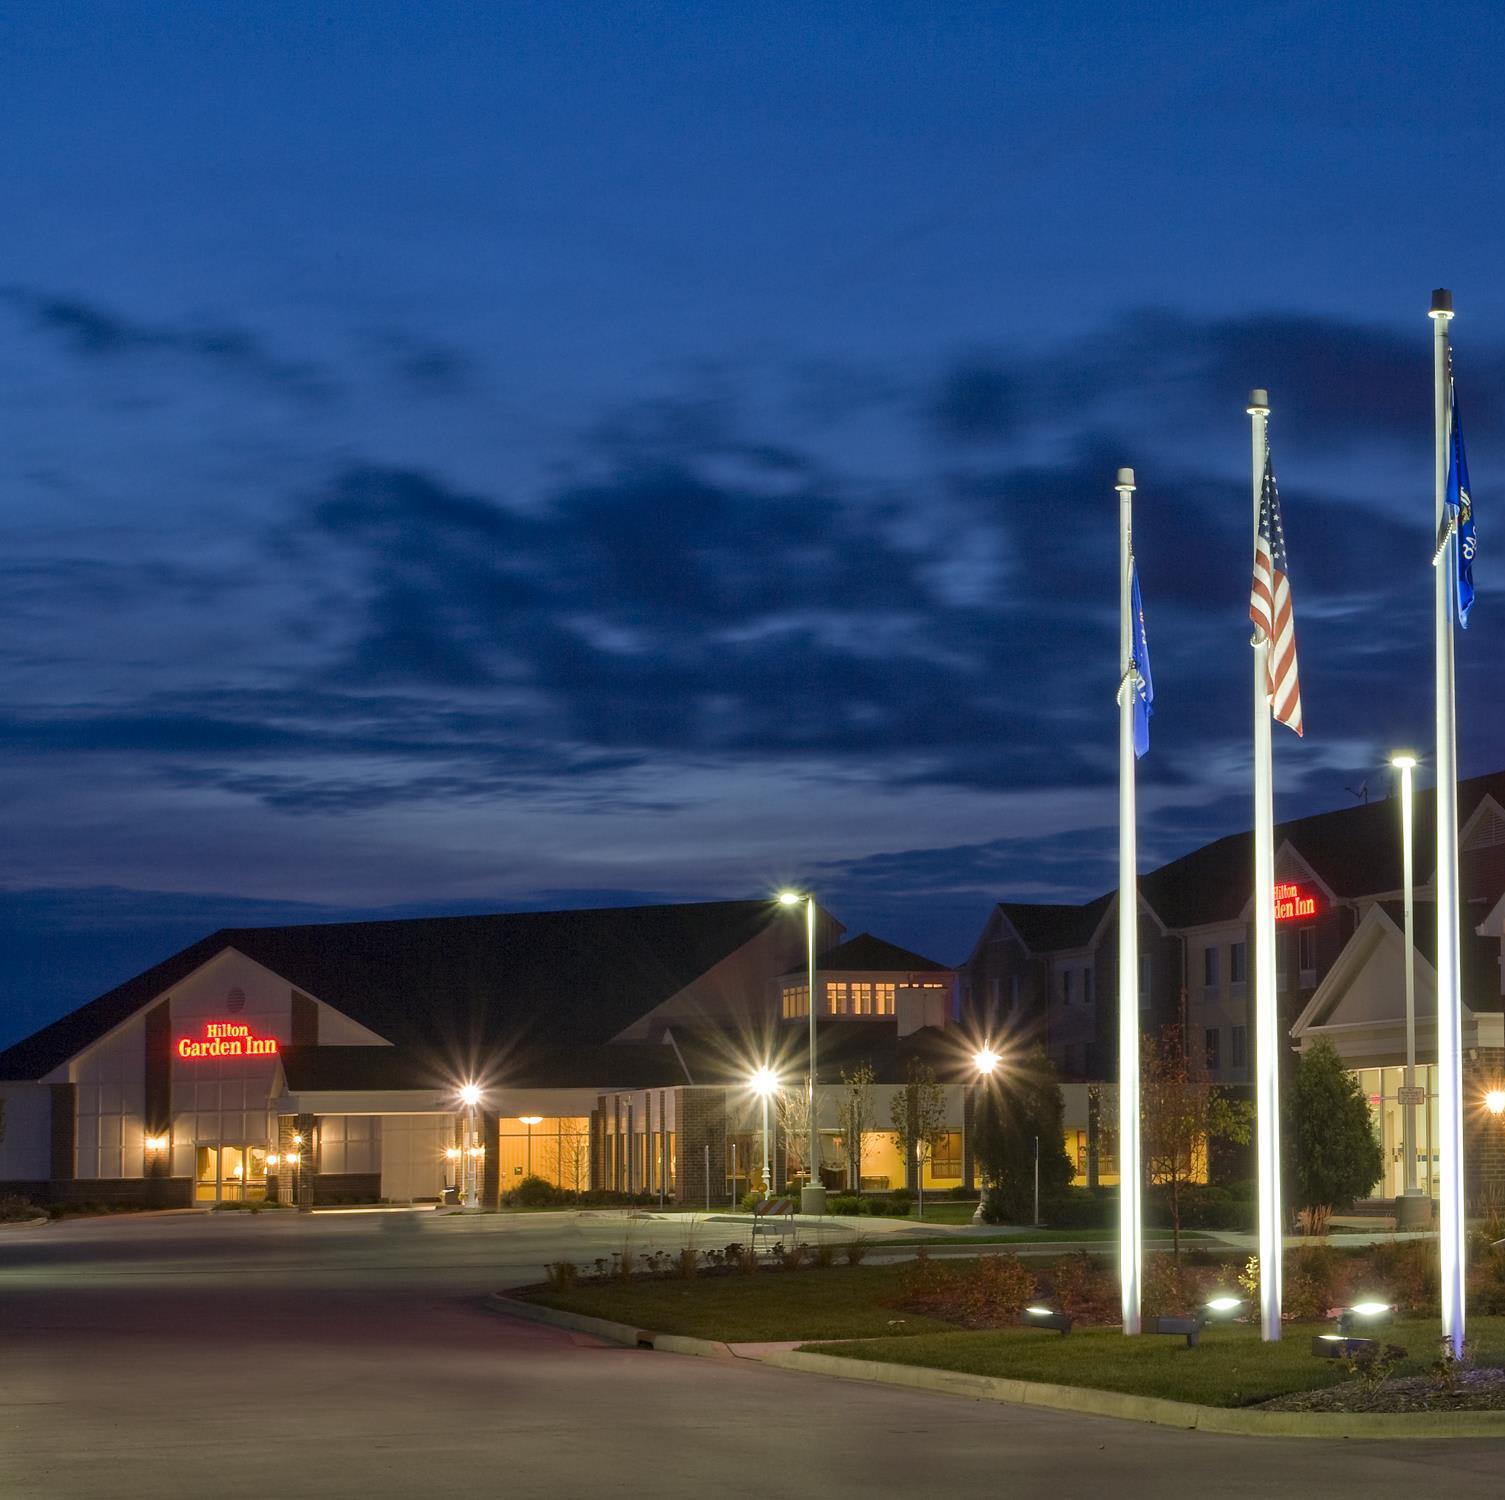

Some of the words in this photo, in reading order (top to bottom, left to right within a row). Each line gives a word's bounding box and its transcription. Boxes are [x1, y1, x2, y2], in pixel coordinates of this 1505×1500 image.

[1274, 900, 1293, 919] den
[1295, 897, 1315, 916] Inn
[207, 1024, 248, 1037] Hilton
[178, 1038, 242, 1057] Garden
[246, 1036, 277, 1054] Inn
